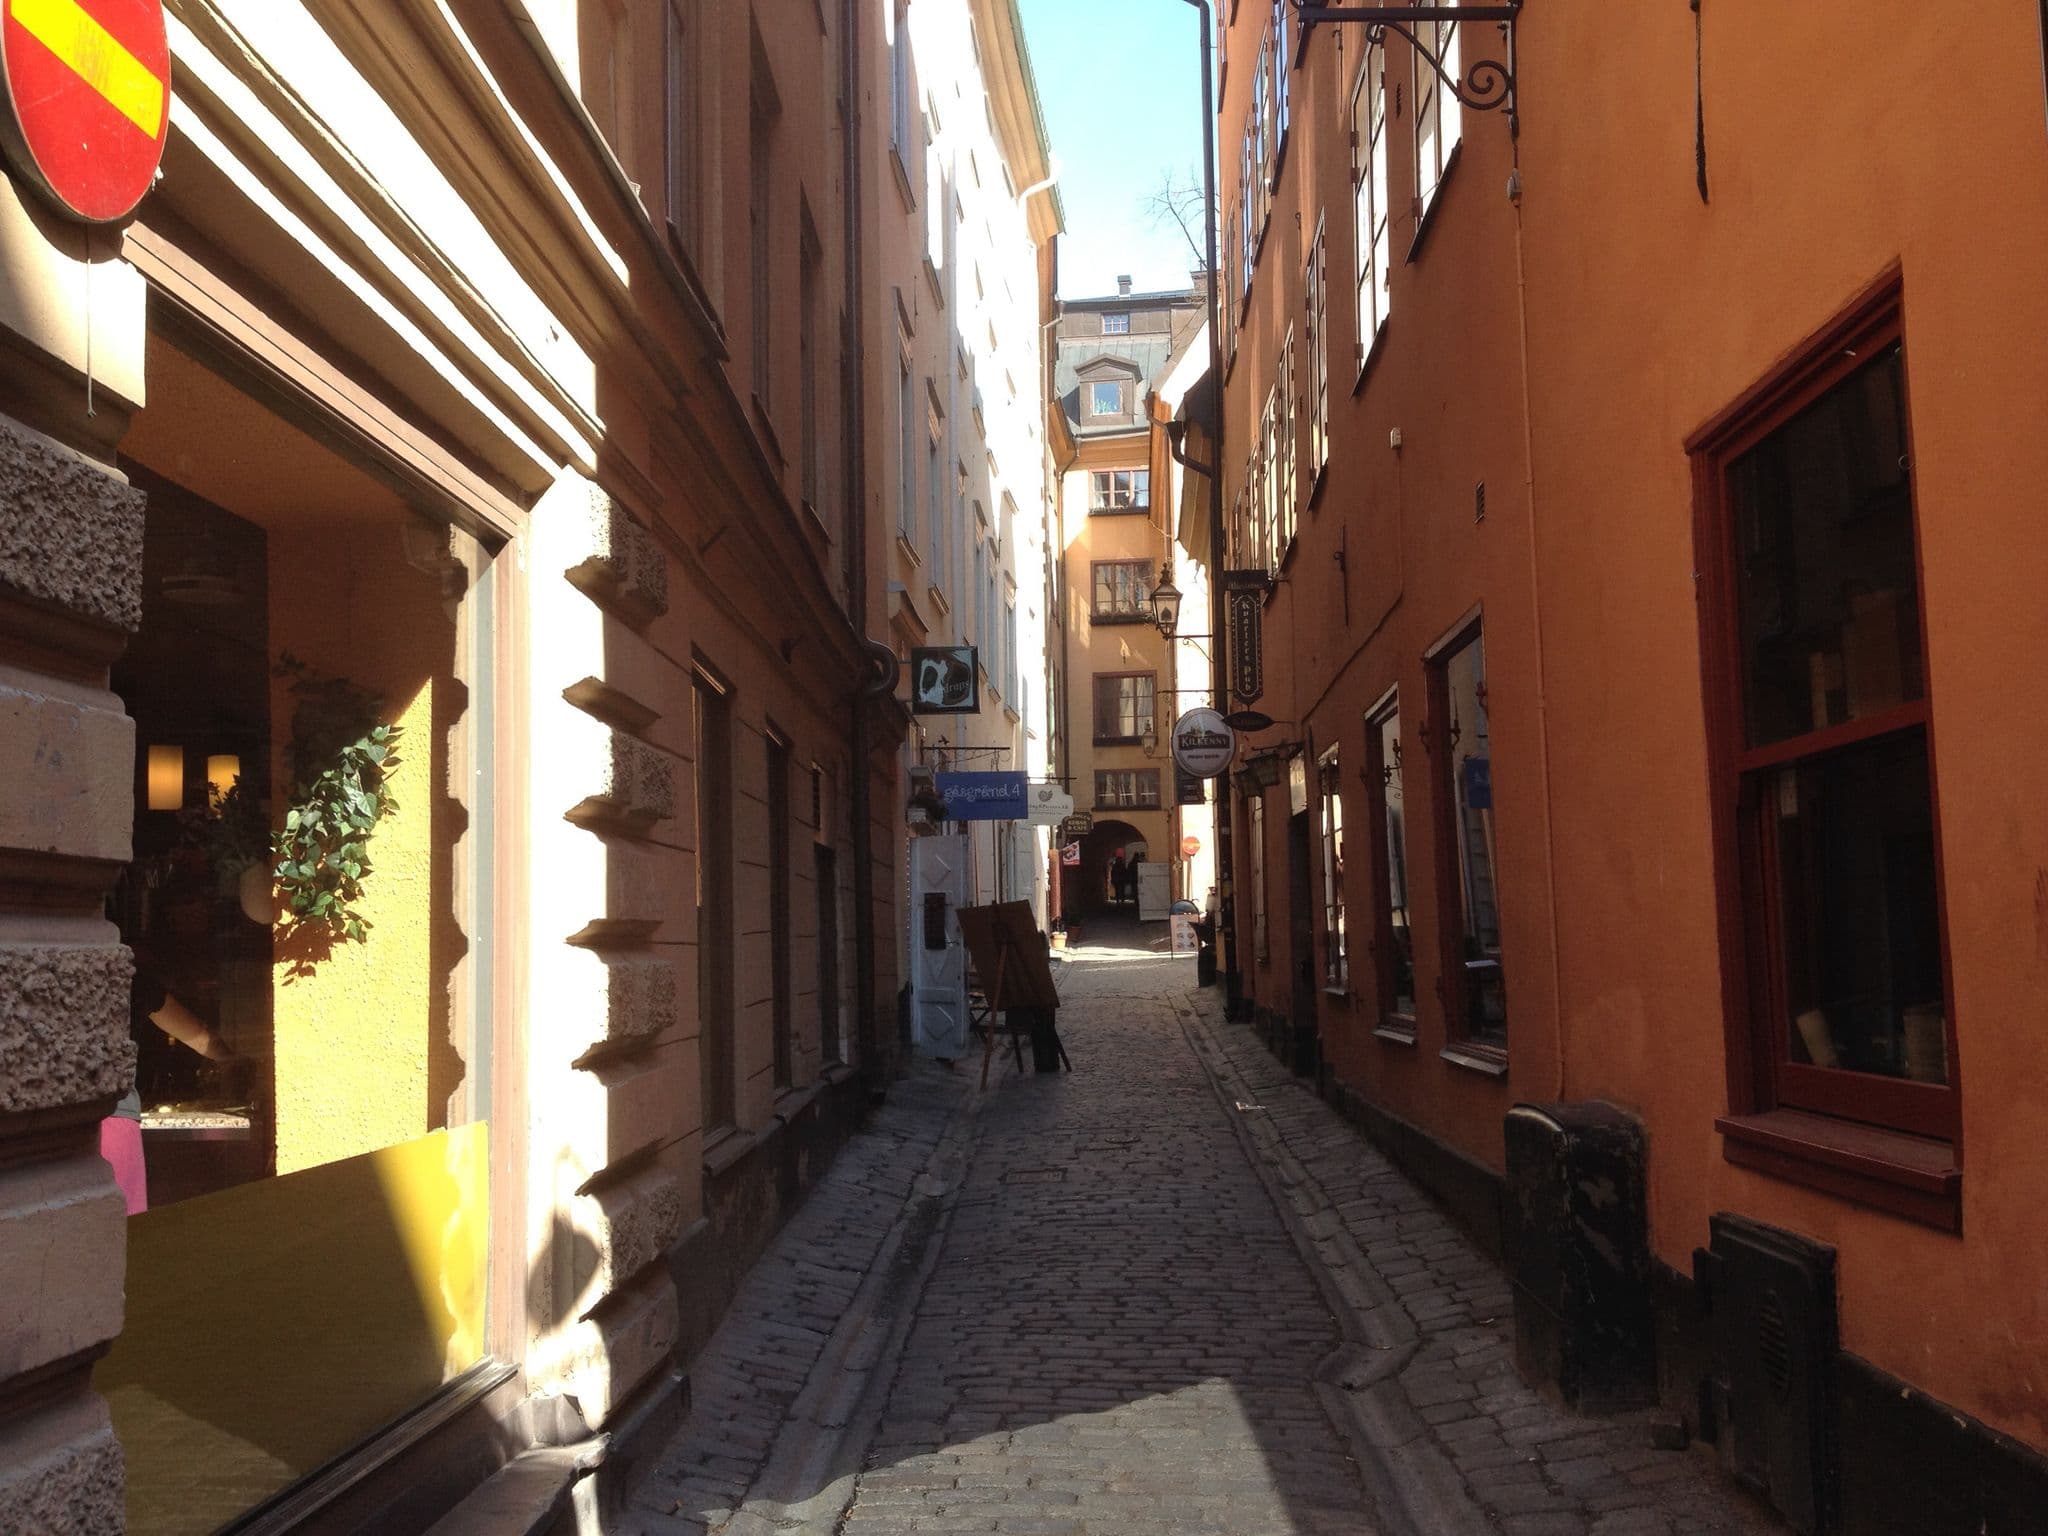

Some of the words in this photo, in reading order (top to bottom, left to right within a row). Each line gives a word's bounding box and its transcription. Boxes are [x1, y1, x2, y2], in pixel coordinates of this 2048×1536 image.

[1243, 666, 1252, 691] Pub
[1182, 736, 1227, 747] KILKENNY
[1012, 783, 1021, 797] 4
